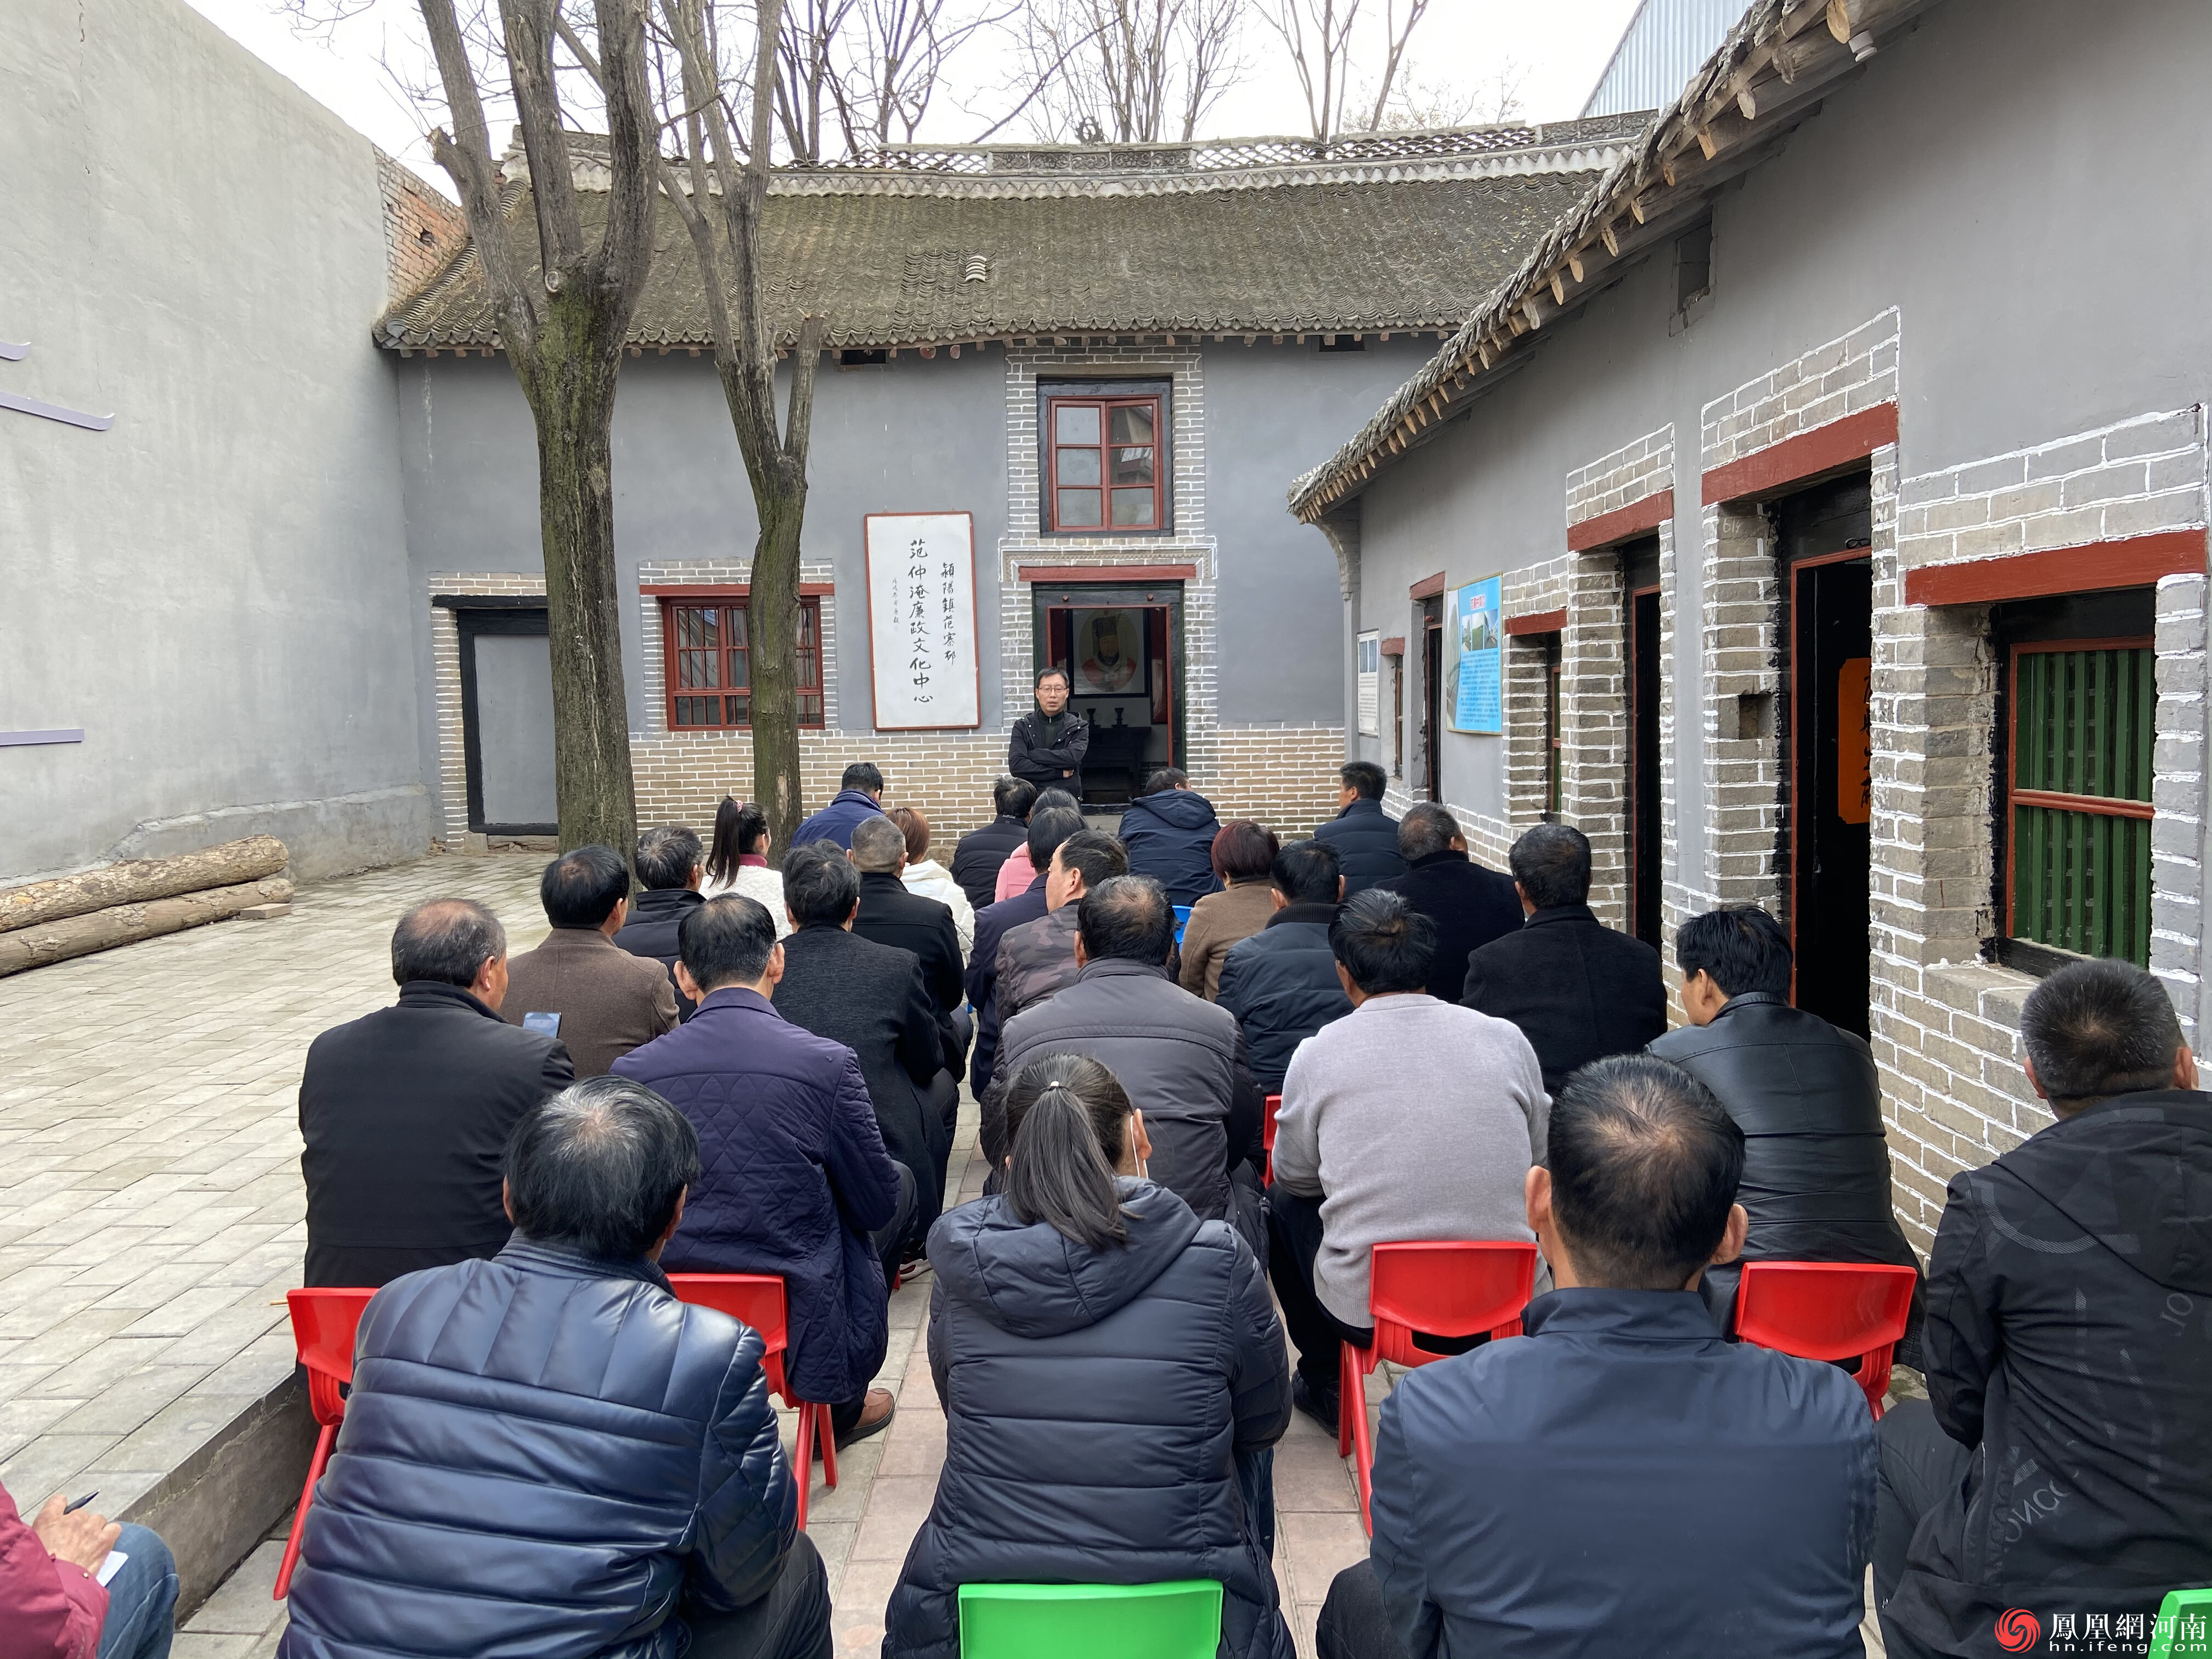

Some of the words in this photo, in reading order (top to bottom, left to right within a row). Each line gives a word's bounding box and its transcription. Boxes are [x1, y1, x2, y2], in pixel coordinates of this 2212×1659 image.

[907, 538, 933, 703] 范仲淹廉政文化中心
